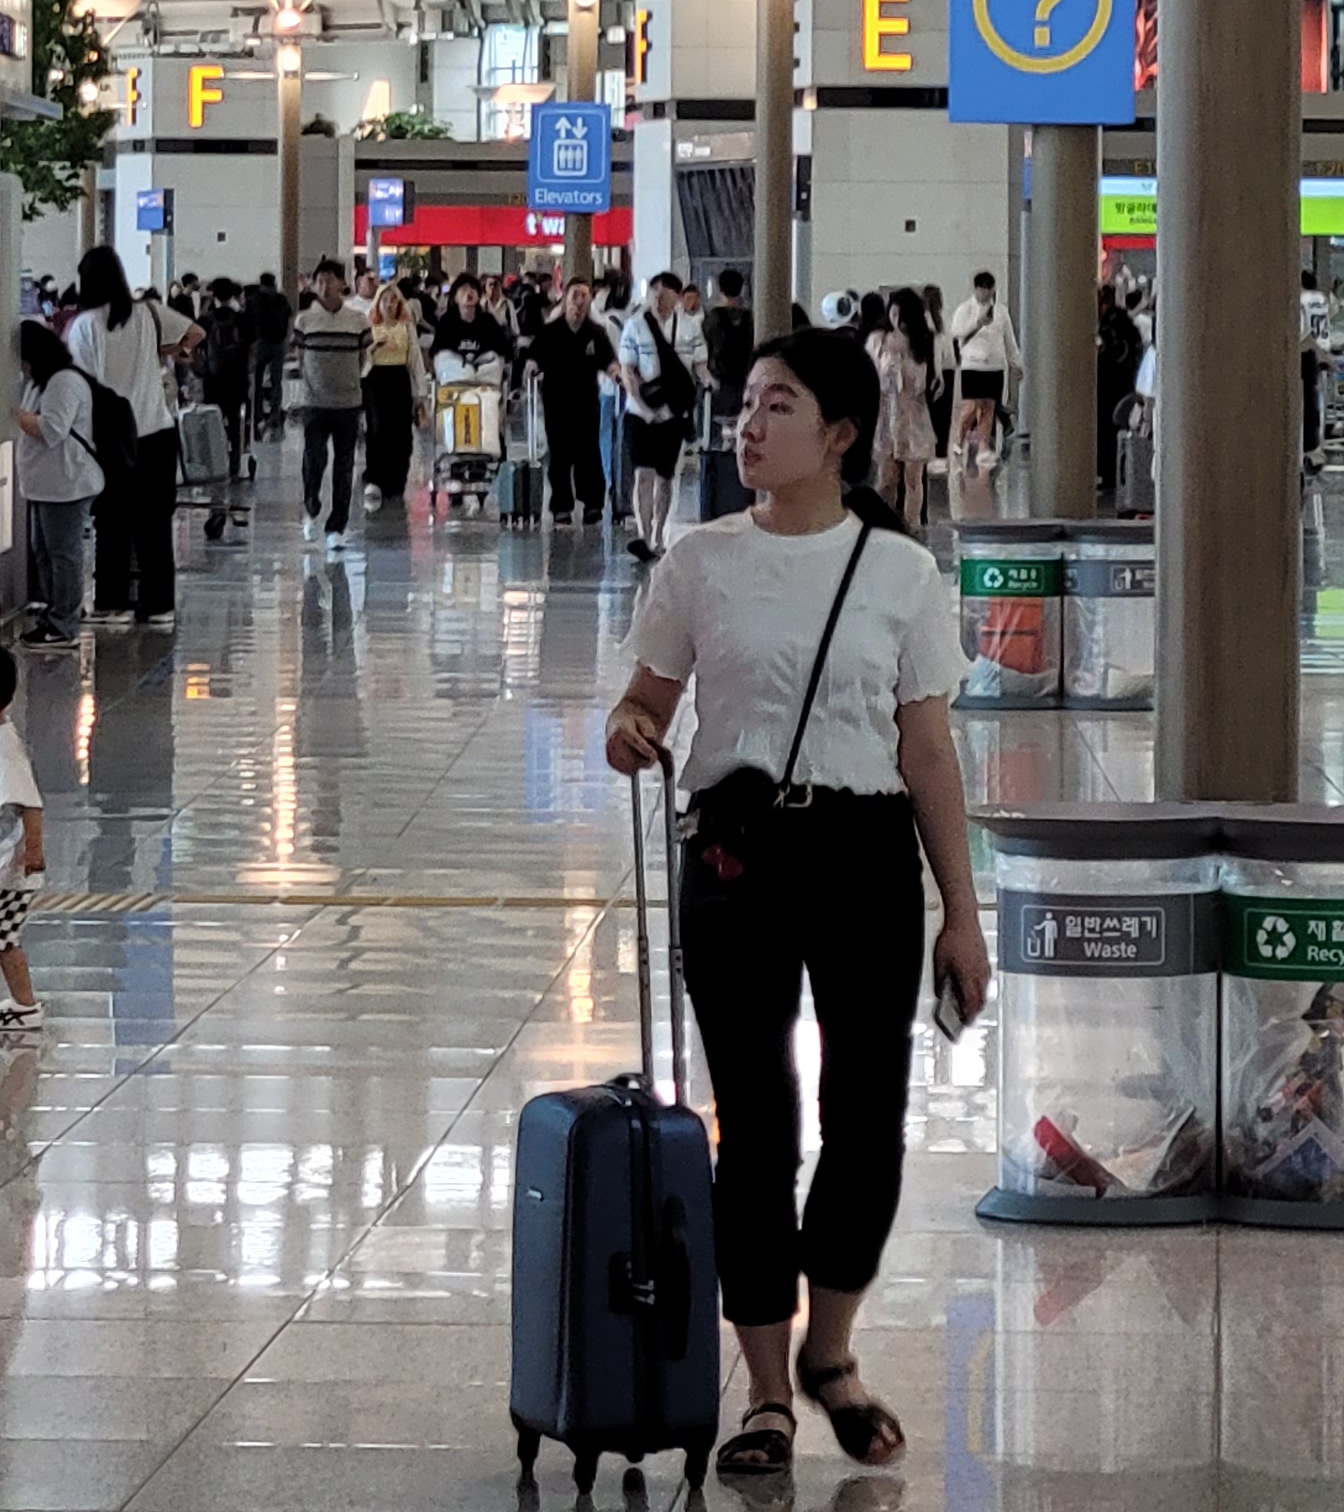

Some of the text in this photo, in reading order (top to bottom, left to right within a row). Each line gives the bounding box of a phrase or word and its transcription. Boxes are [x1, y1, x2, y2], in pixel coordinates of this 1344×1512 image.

[187, 64, 225, 129] F
[1133, 161, 1154, 175] E1
[534, 188, 603, 205] Elevators
[1065, 915, 1157, 939] 일반쓰레기
[1083, 941, 1138, 958] Waste
